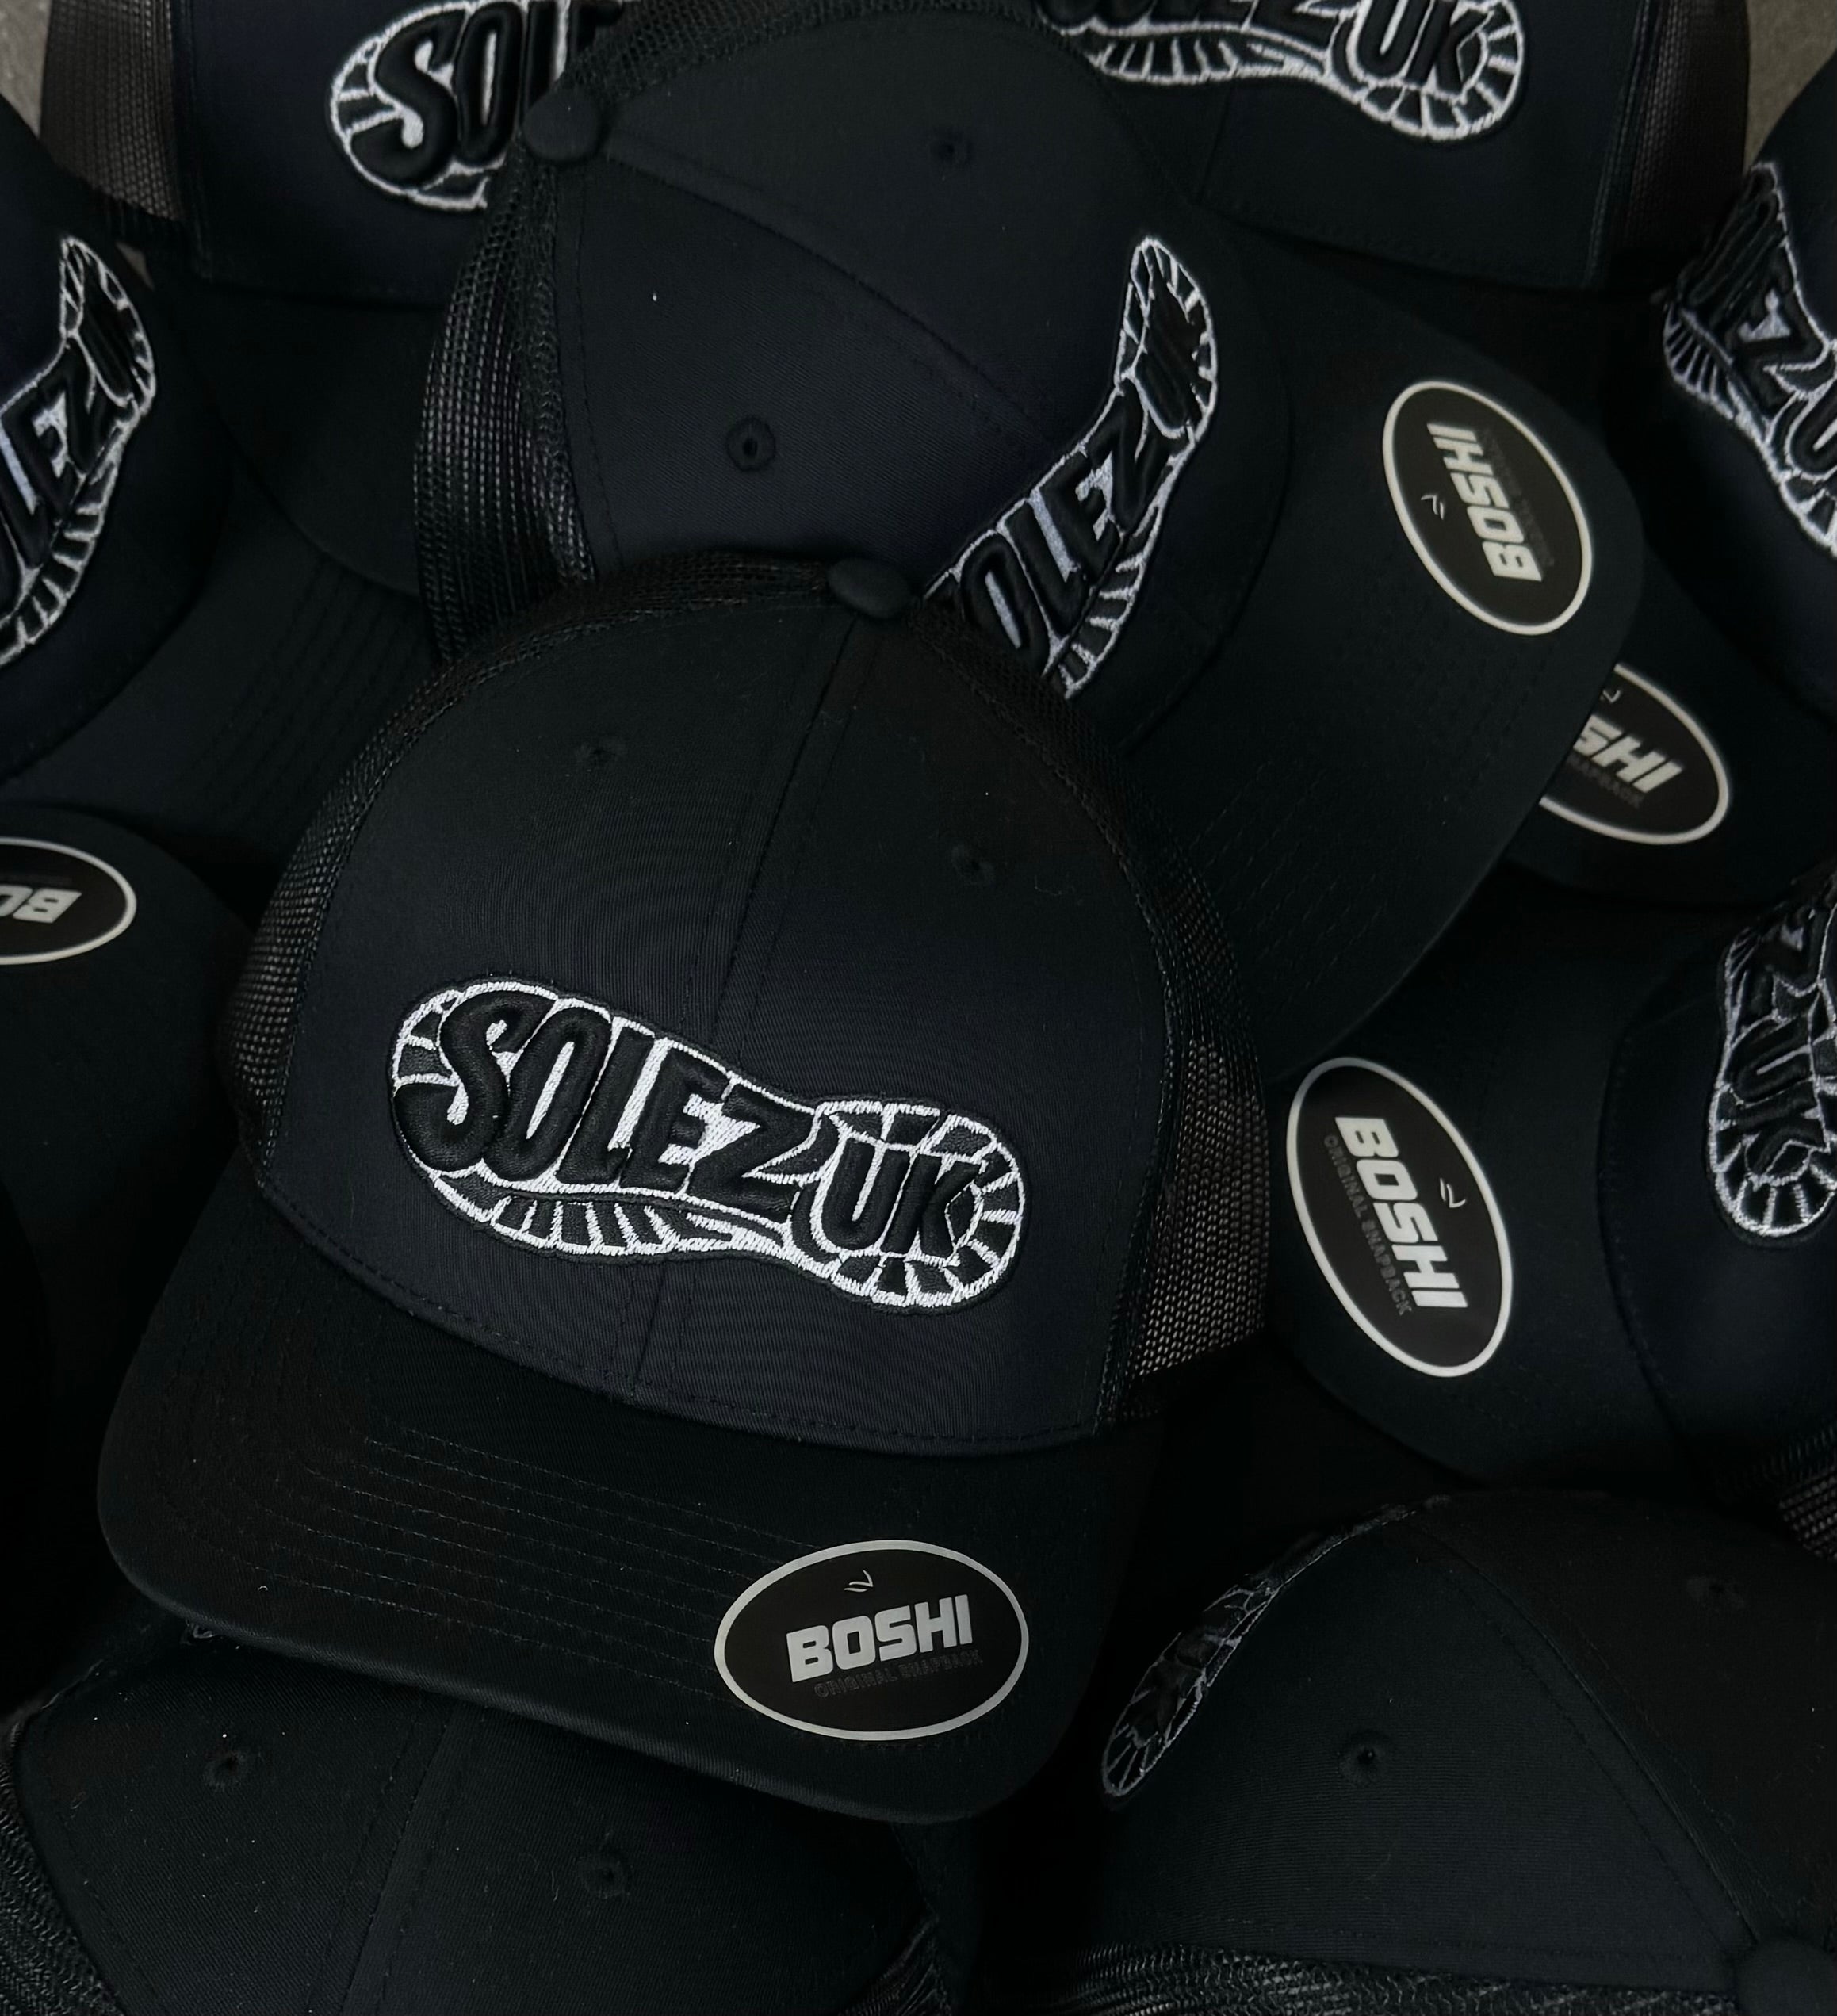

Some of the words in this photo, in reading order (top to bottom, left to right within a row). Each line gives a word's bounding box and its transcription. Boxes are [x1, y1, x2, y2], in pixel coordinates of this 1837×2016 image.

[940, 387, 1187, 670] OLEZ
[1426, 423, 1544, 582] BOSHI
[396, 990, 817, 1221] SOLEZ
[820, 1136, 985, 1260] UK
[1334, 1115, 1469, 1308] BOSHI
[1323, 1134, 1369, 1218] ORIGINAL
[1361, 1218, 1414, 1317] SNAPBACK
[786, 1593, 974, 1683] BOSHI
[813, 1666, 898, 1698] ORIGINAL
